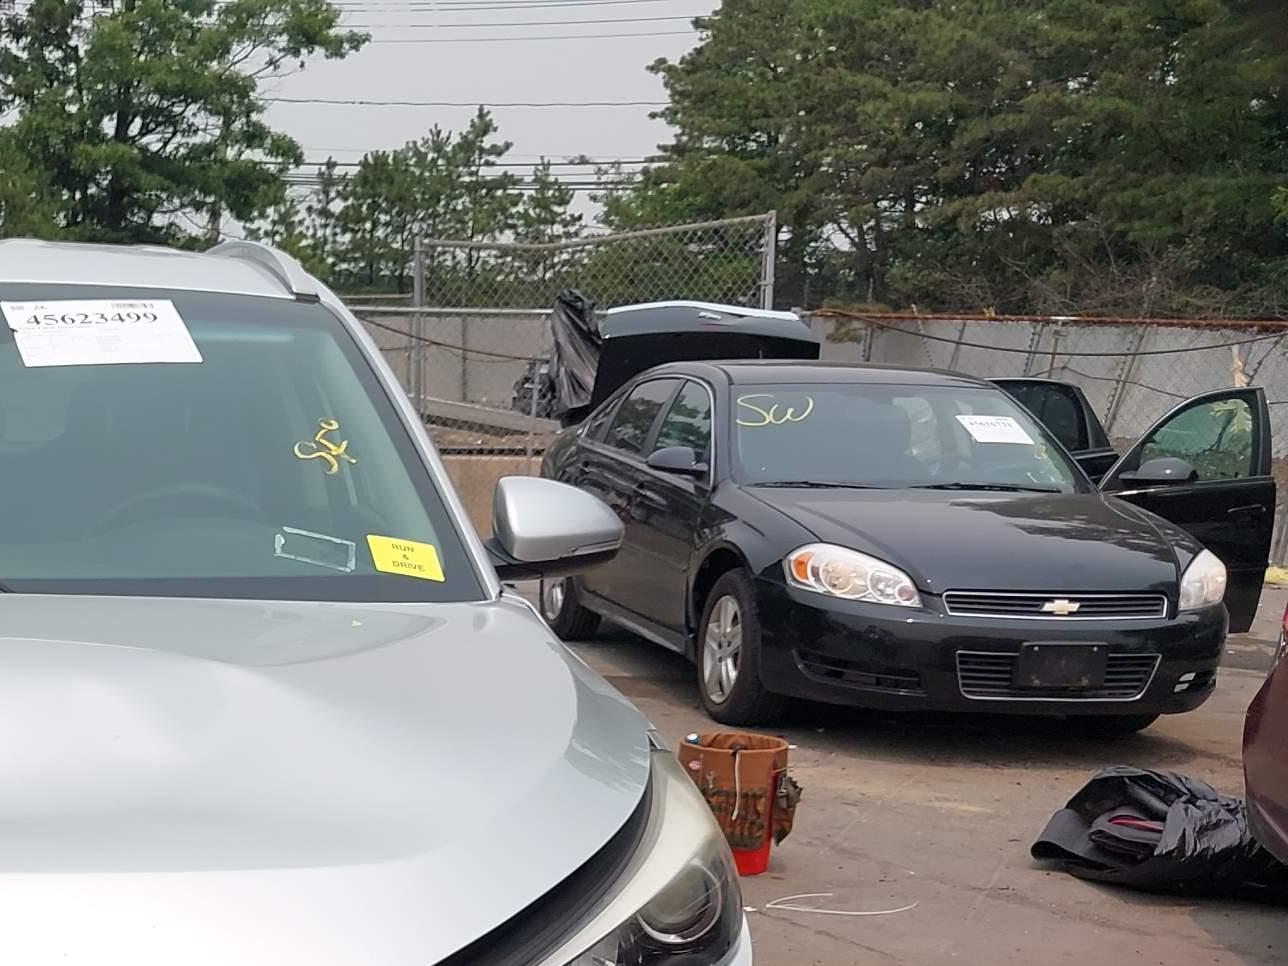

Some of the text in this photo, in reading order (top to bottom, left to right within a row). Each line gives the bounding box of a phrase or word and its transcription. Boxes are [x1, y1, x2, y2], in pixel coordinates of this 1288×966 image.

[25, 311, 159, 326] 45623499
[392, 544, 414, 552] RUN
[392, 561, 425, 571] DRIVE
